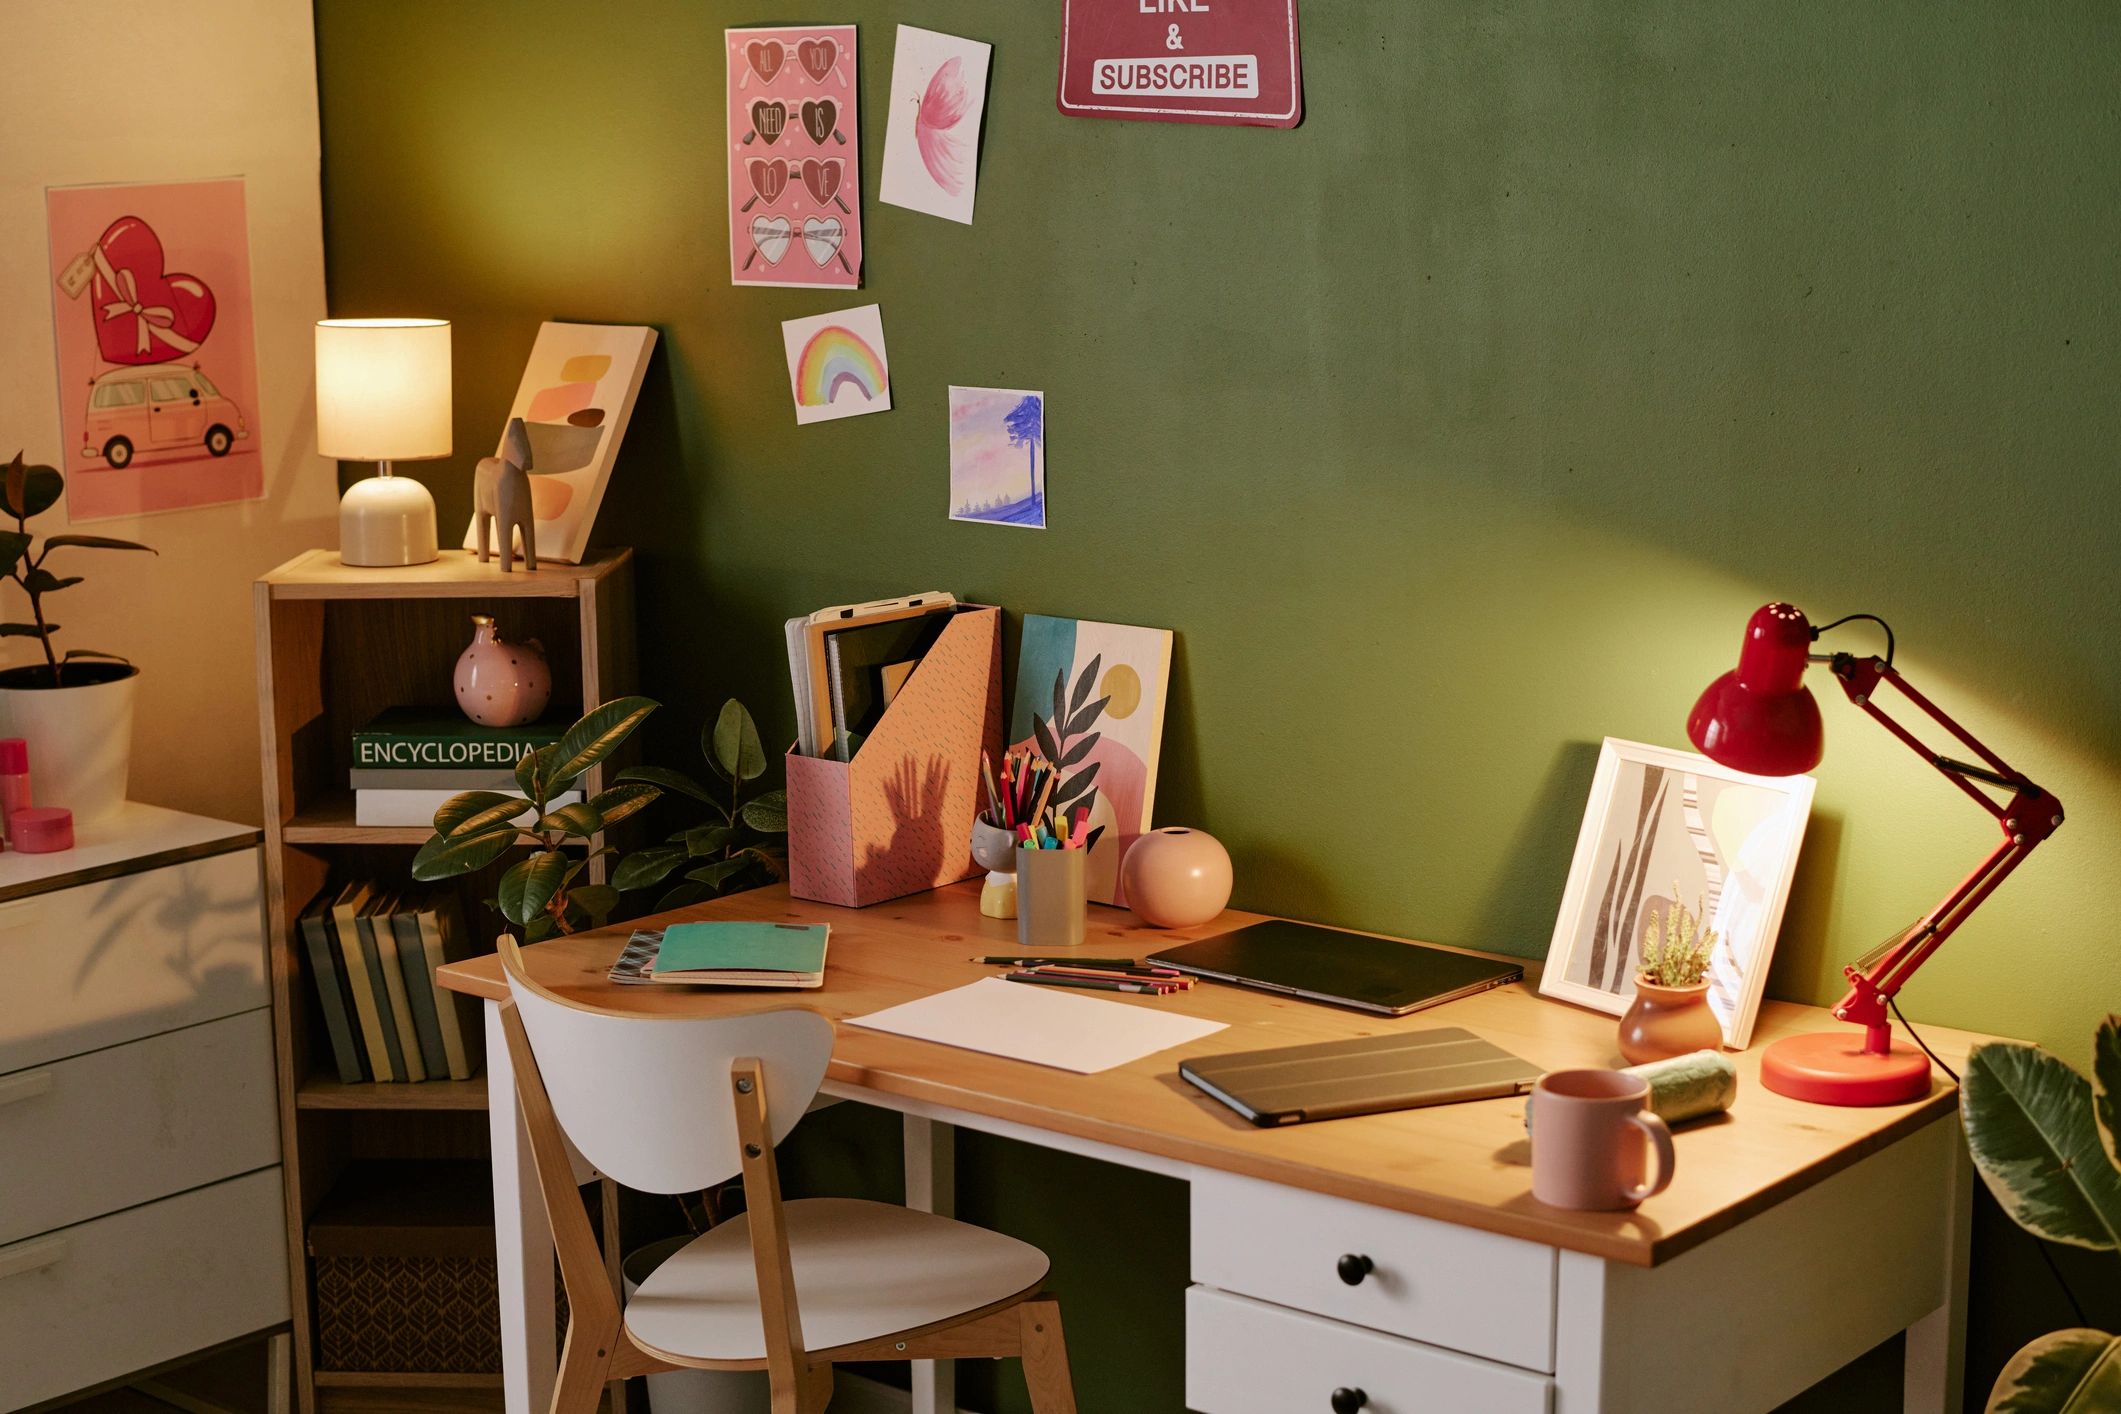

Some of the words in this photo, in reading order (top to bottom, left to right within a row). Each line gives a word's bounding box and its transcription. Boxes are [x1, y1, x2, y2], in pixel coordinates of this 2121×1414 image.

[1166, 23, 1184, 50] &
[760, 49, 773, 72] ALL
[810, 47, 828, 70] YOU
[1100, 64, 1248, 89] SUBSCRIBE
[759, 107, 781, 134] NEED
[815, 107, 824, 138] IS
[360, 742, 534, 763] ENCYCLOPEDIA
